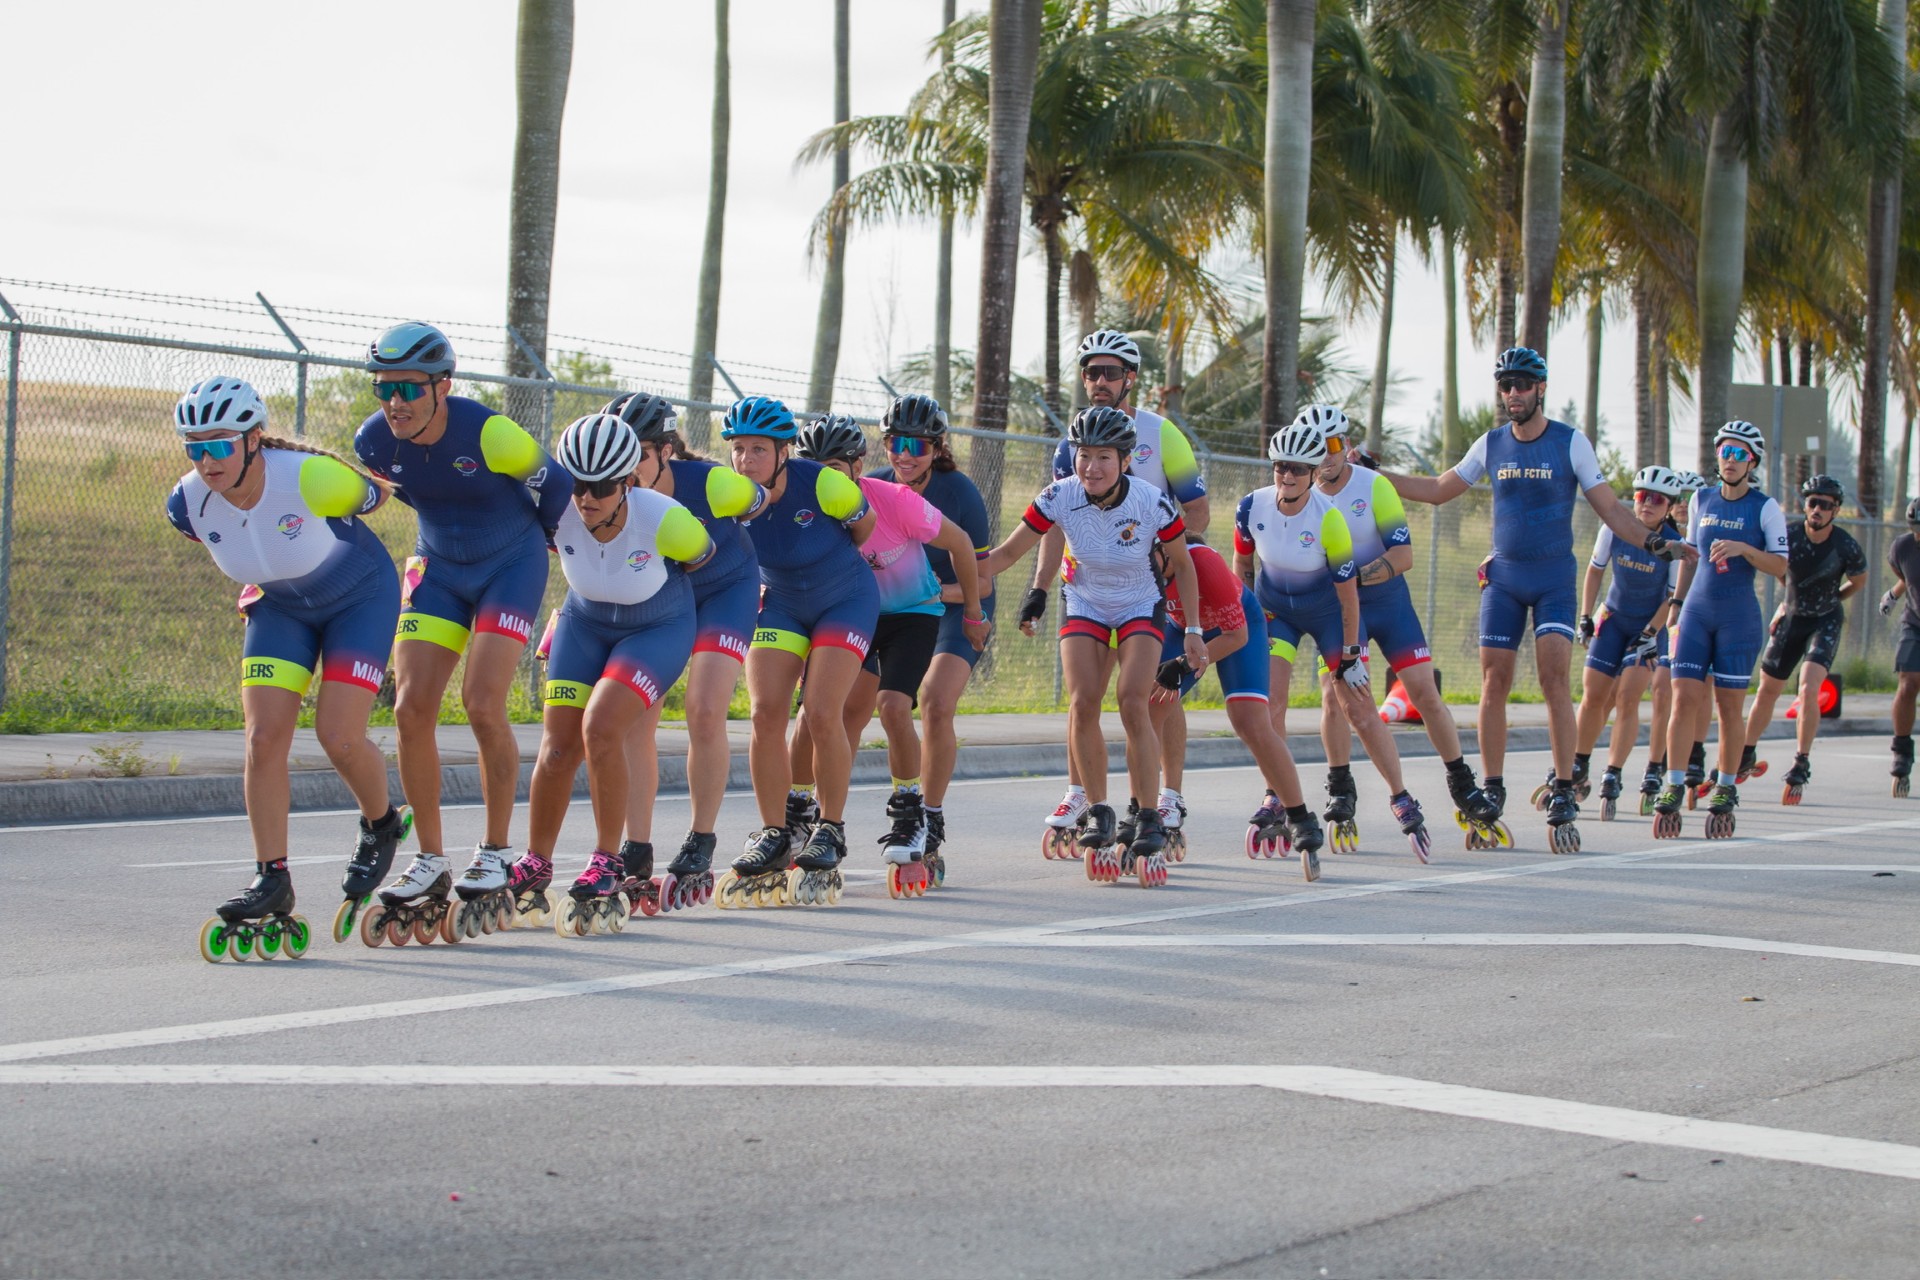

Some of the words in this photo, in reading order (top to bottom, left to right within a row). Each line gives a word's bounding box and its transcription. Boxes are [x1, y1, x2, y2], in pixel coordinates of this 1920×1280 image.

[1497, 468, 1521, 480] CSTM
[1524, 468, 1553, 480] FCTRY
[1699, 516, 1719, 528] CSTM
[1719, 519, 1745, 530] FCTRY
[1634, 561, 1655, 573] FCTRY
